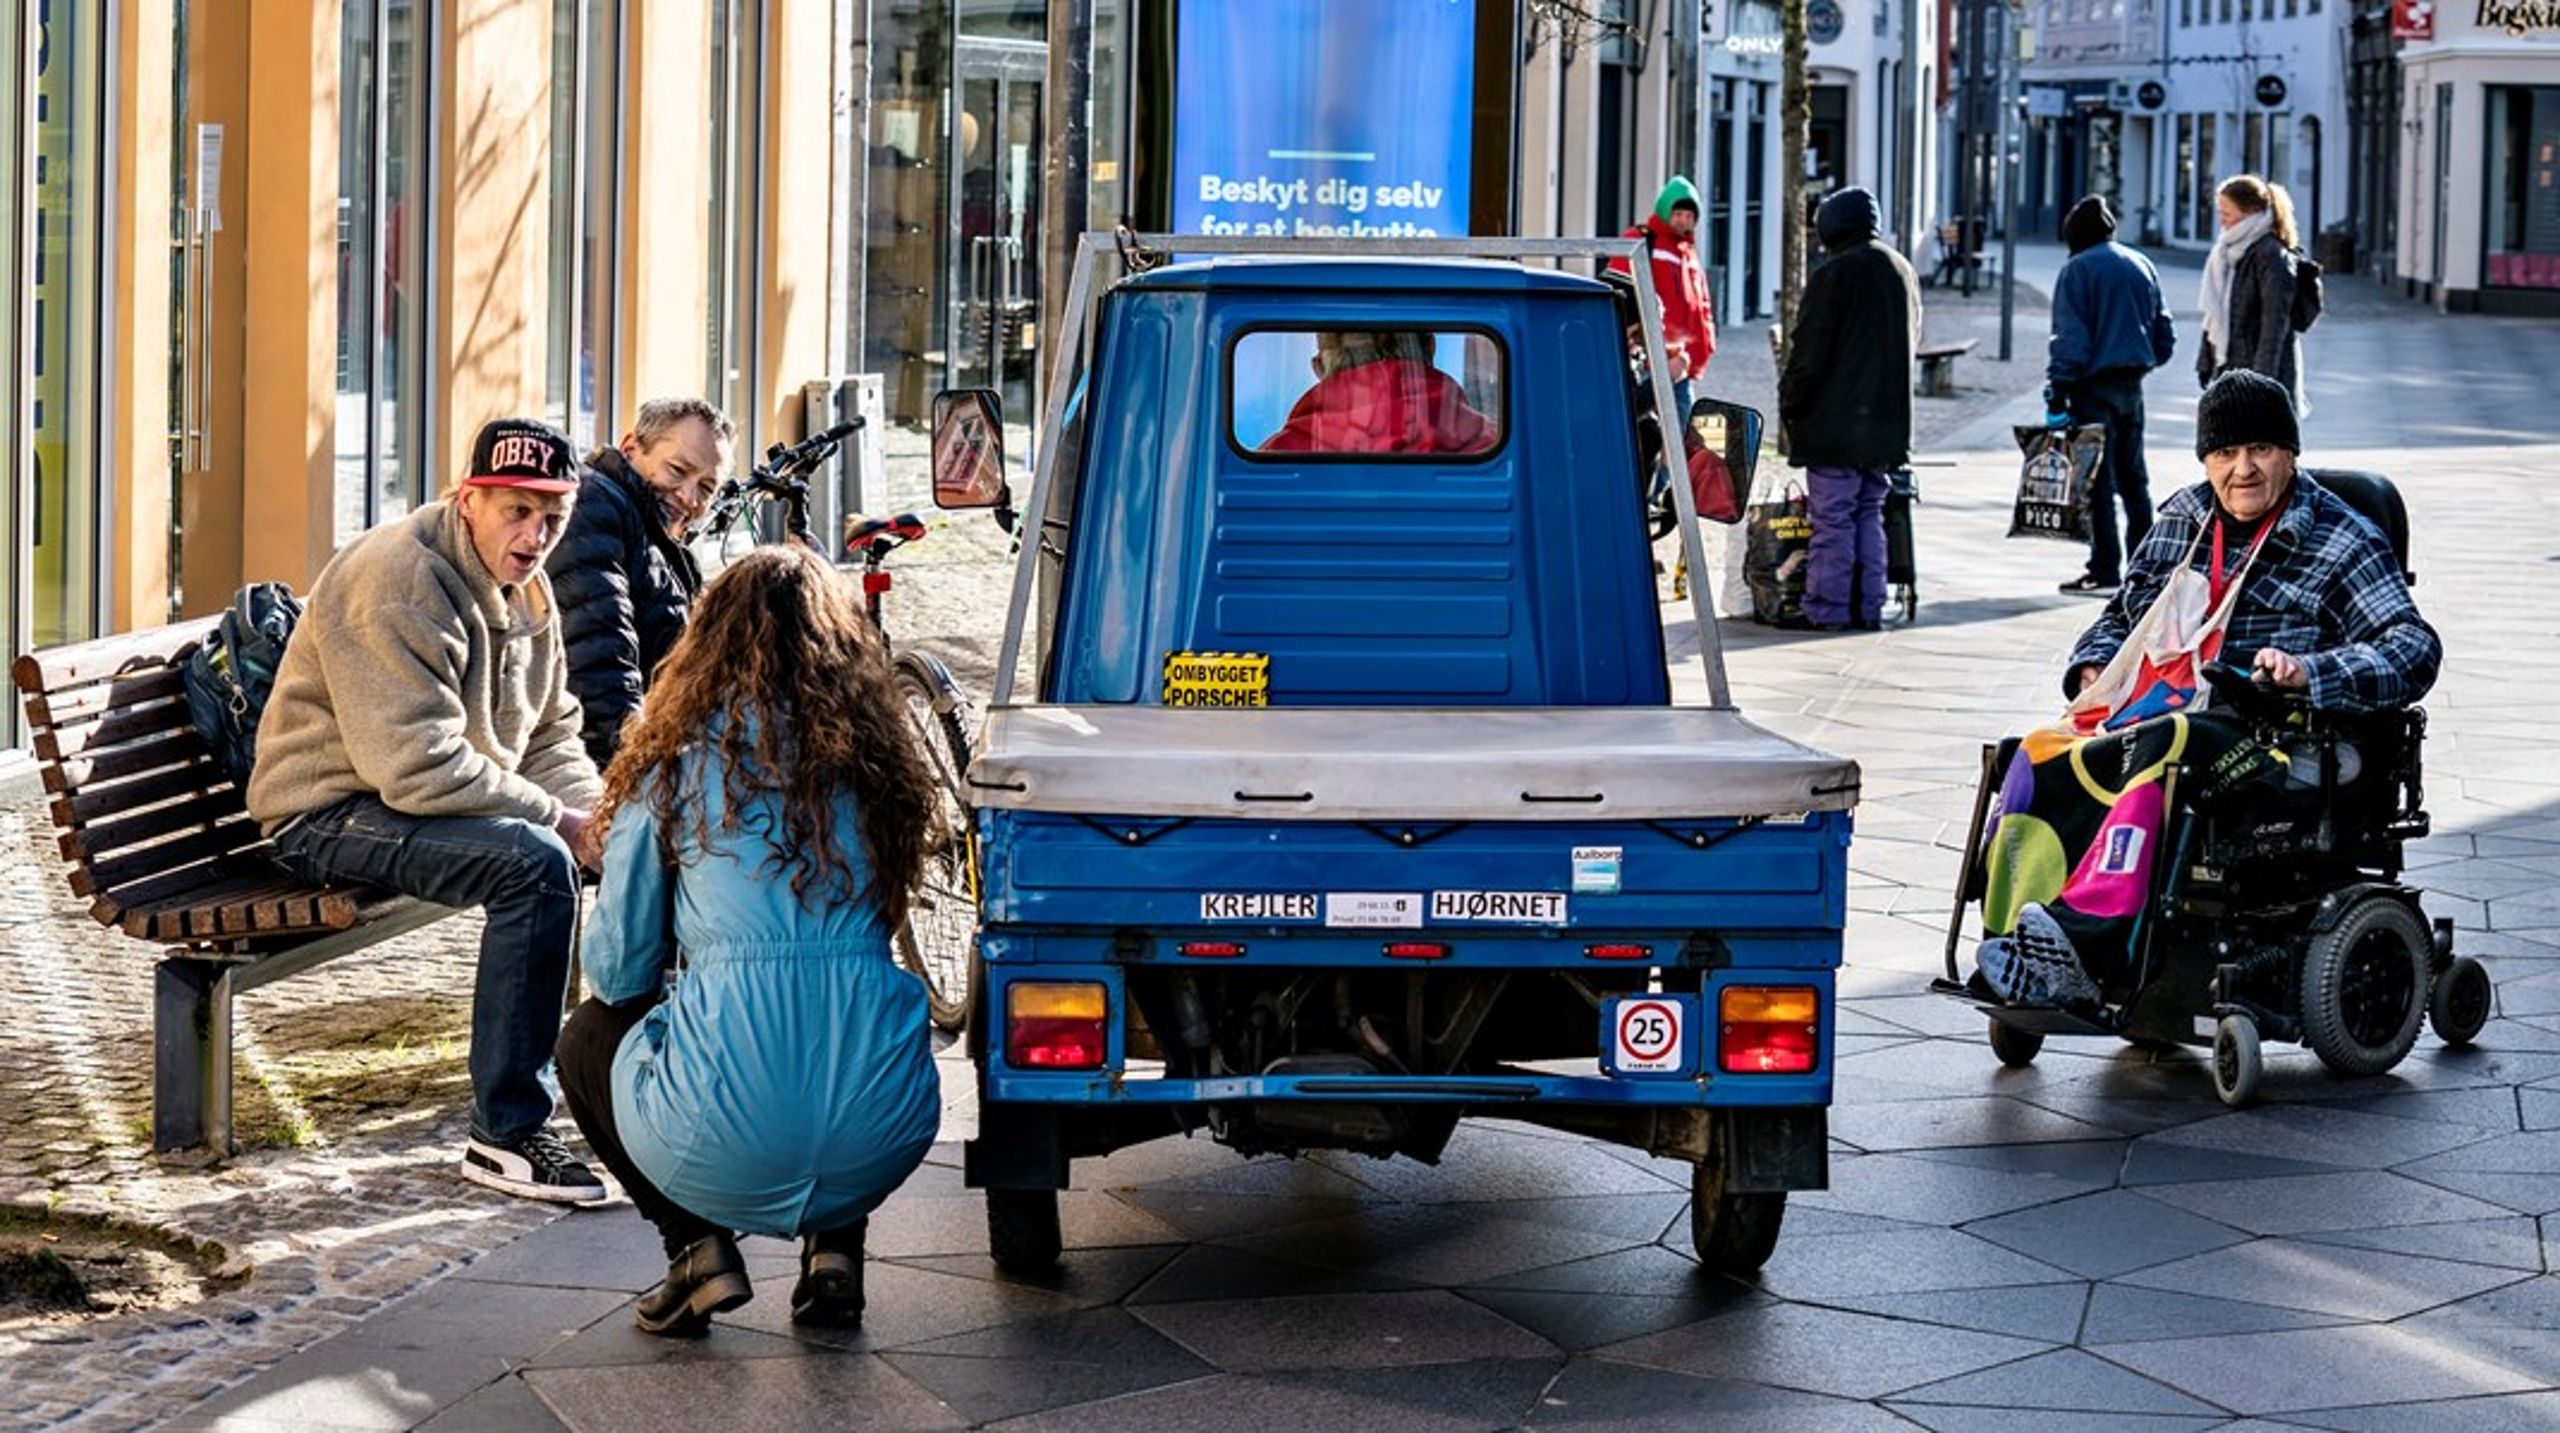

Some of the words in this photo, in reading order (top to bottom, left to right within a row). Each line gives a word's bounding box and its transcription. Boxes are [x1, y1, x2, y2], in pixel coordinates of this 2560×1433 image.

[1724, 36, 1784, 53] ONLY
[1200, 175, 1309, 211] Beskyt
[1314, 179, 1368, 213] dig
[1375, 180, 1443, 209] selv
[1201, 214, 1248, 237] for
[1255, 218, 1287, 237] at
[492, 437, 554, 475] OBEY
[1172, 664, 1259, 682] OMBYGGET
[1171, 688, 1259, 707] PORSCHE
[1573, 849, 1623, 861] Aalborg
[1204, 894, 1316, 918] KREJLER
[1434, 891, 1562, 918] HJØRNET
[1631, 1018, 1664, 1045] 25
